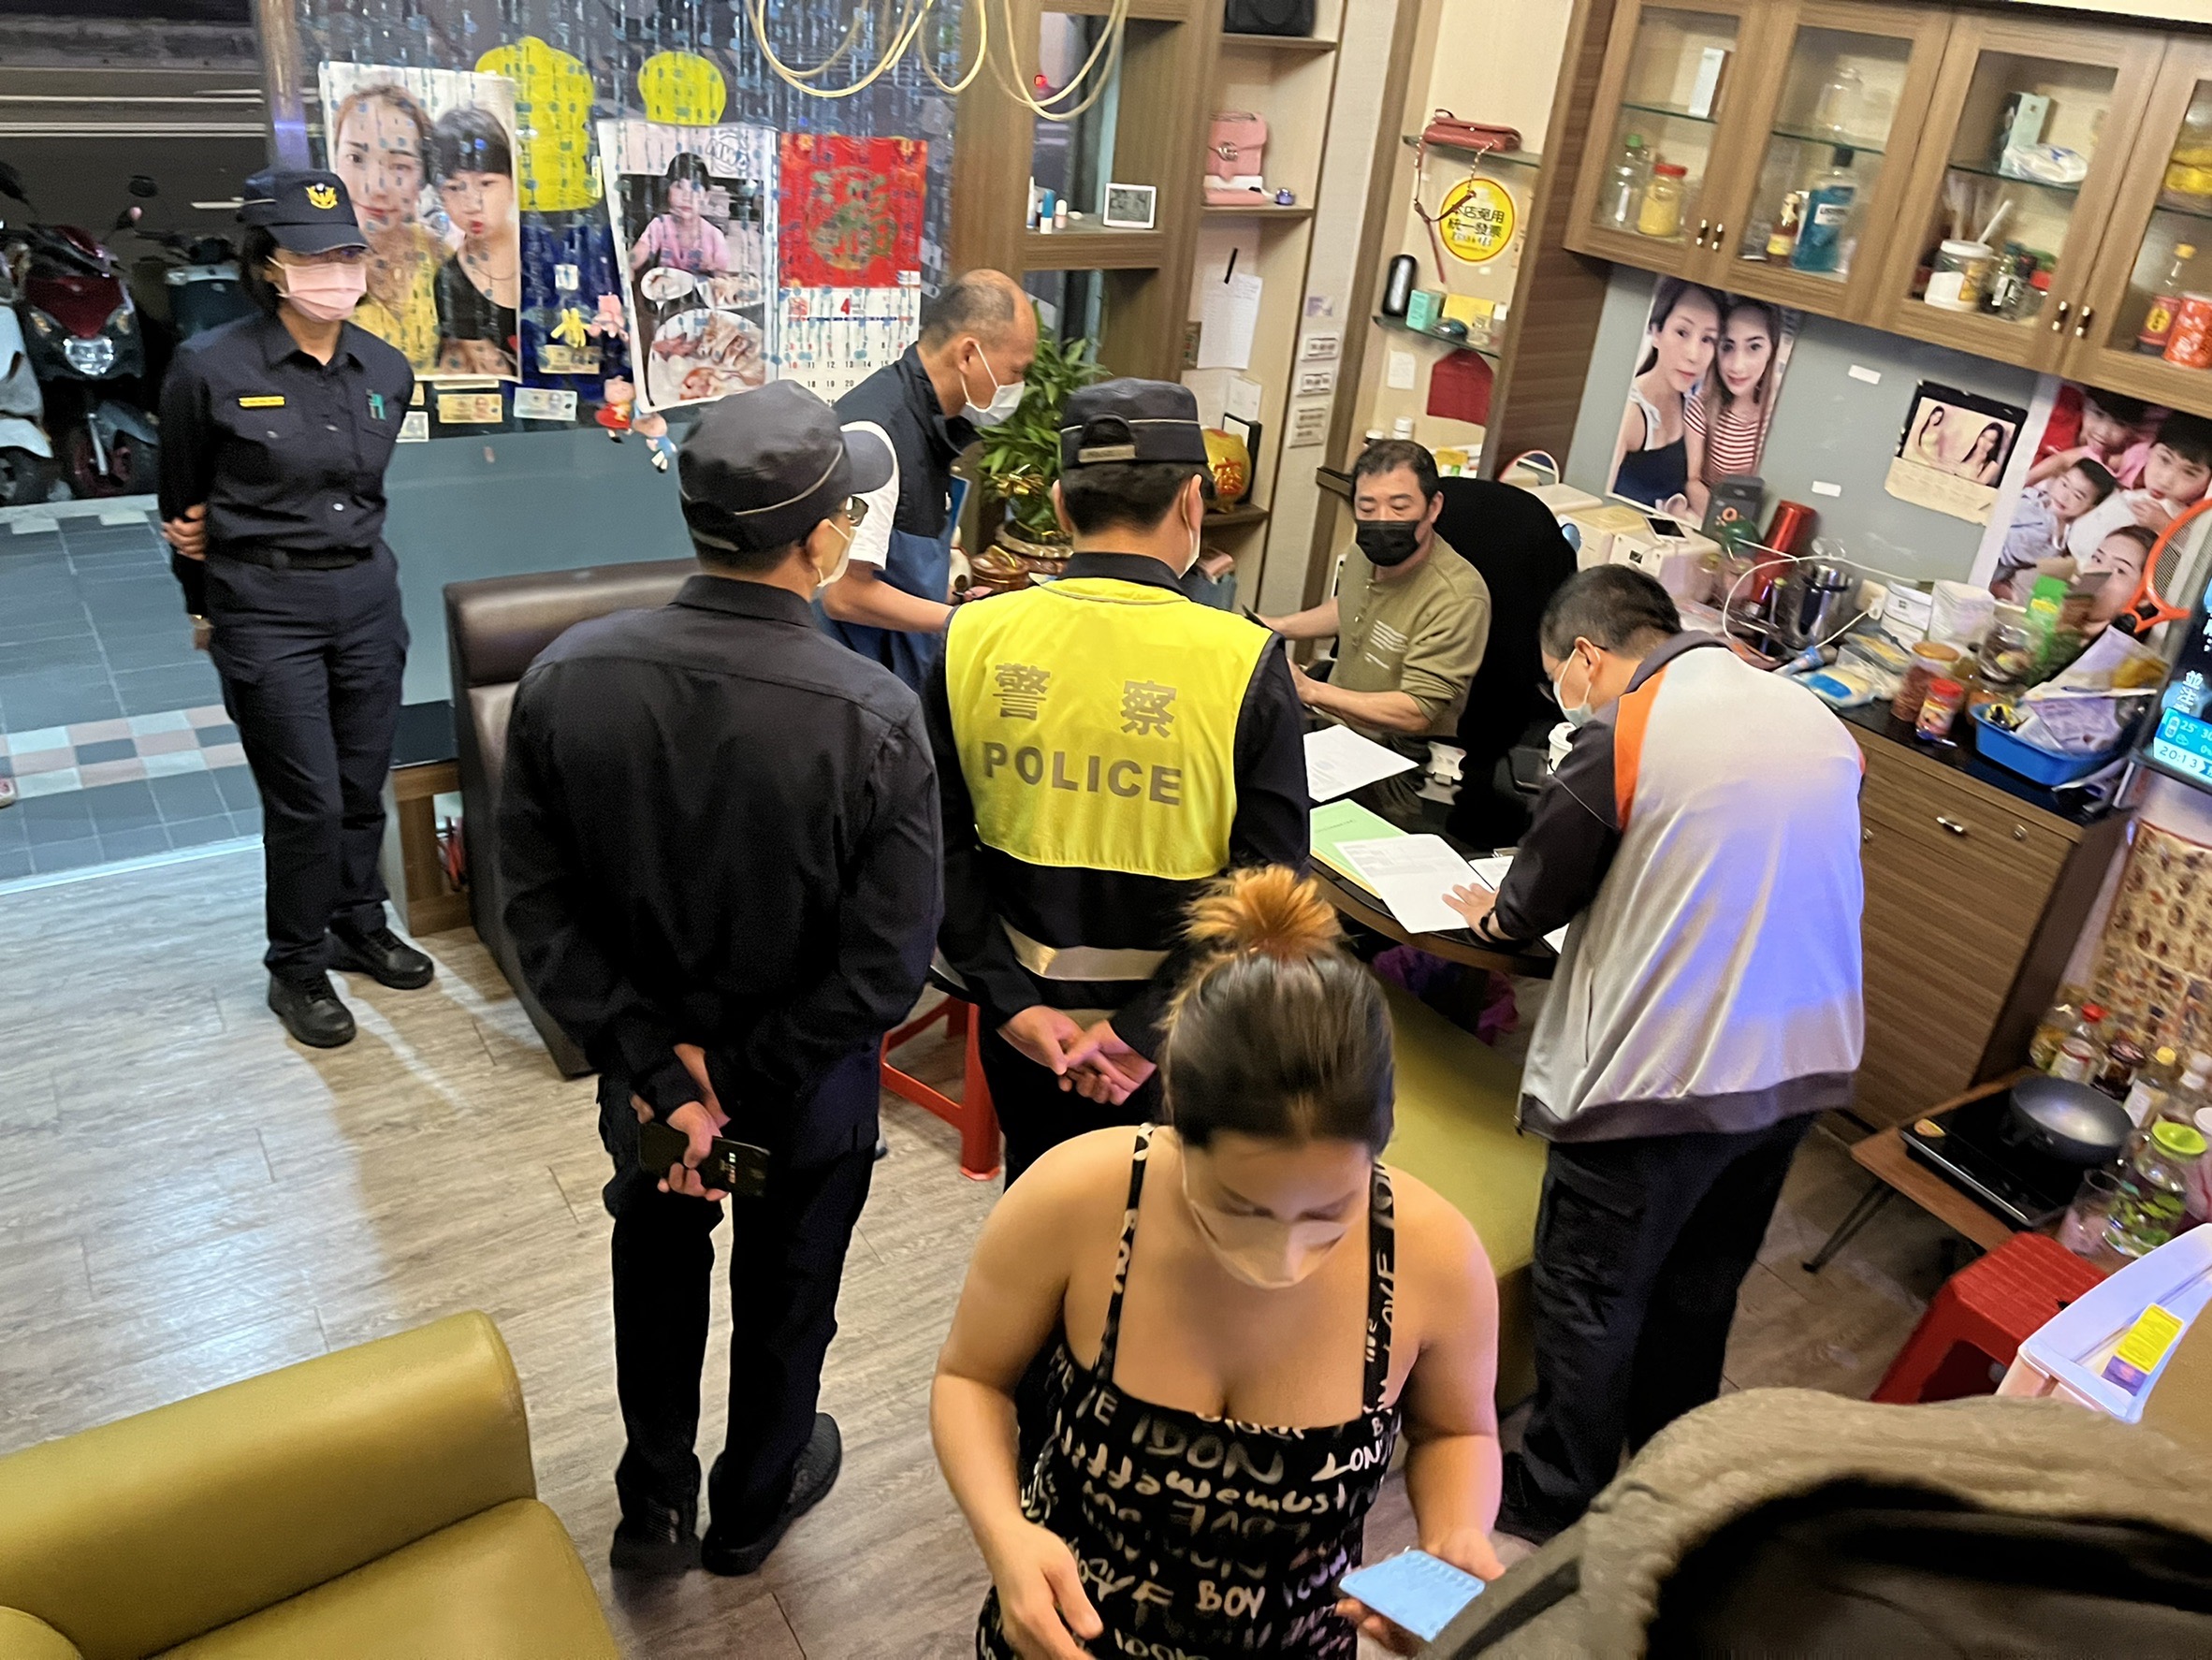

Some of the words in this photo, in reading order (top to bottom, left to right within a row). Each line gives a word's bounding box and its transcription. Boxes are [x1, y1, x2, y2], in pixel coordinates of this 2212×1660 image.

[840, 298, 851, 315] 4
[808, 361, 815, 370] 11
[826, 380, 836, 388] 19
[845, 380, 855, 388] 20
[982, 742, 1182, 806] POLICE
[1196, 1580, 1266, 1619] BOY
